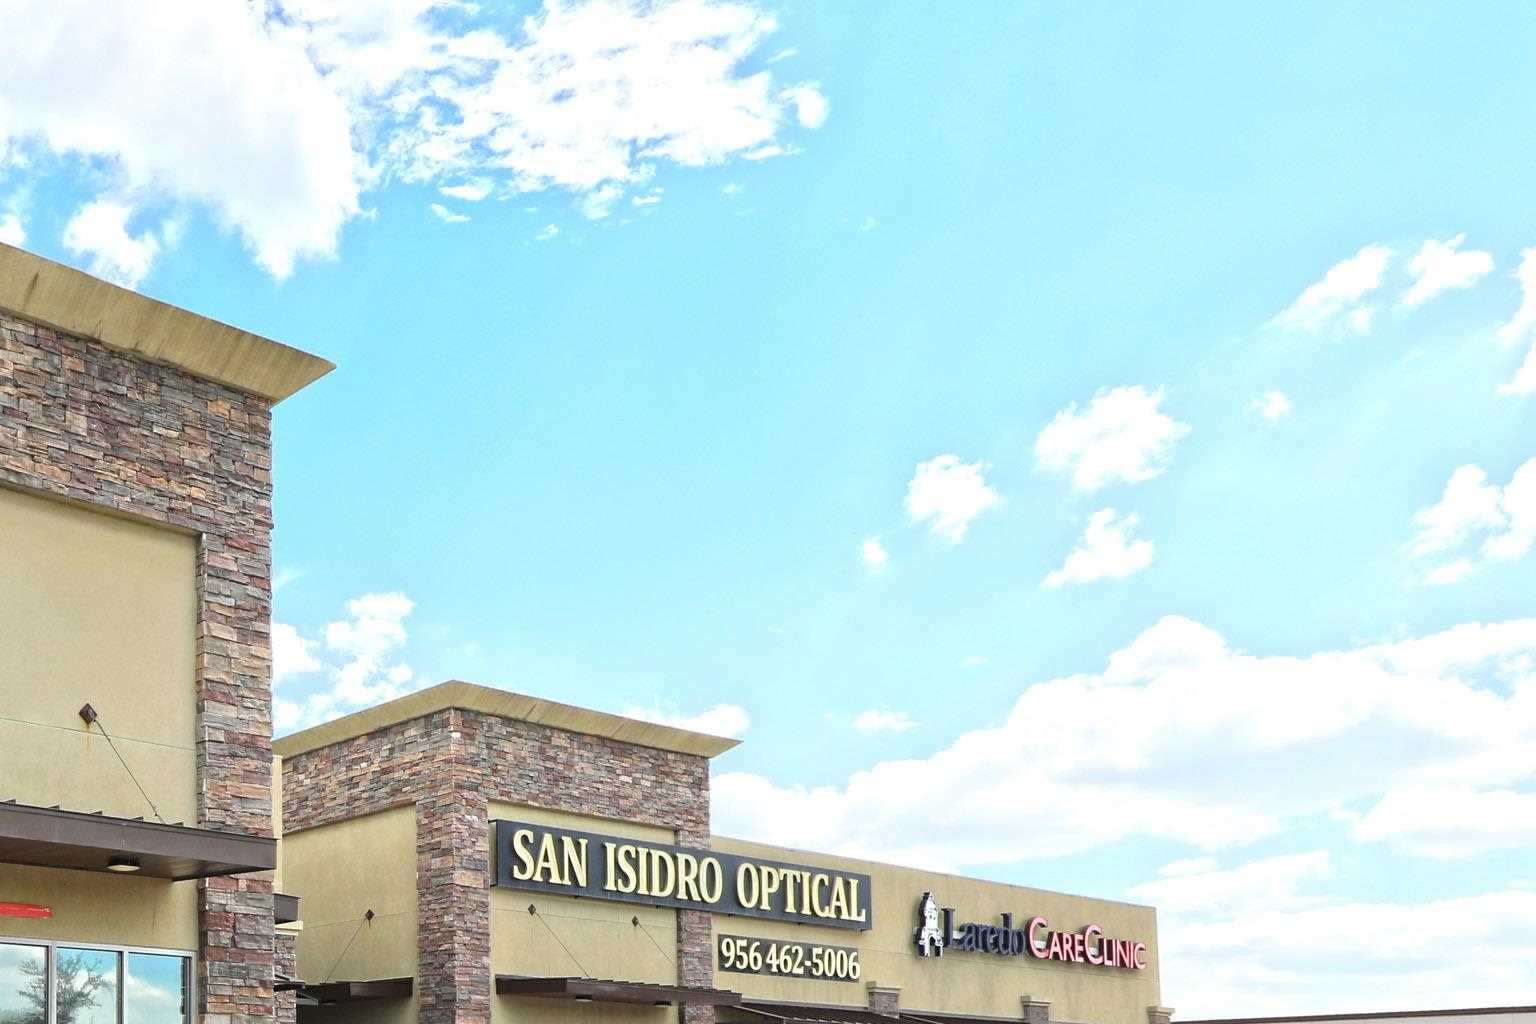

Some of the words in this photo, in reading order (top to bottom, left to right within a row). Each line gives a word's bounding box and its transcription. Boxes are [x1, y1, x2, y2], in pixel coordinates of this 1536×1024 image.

[513, 829, 589, 888] SAN
[603, 842, 724, 903] ISIDRO
[736, 862, 867, 922] OPTICAL
[941, 907, 1027, 956] Laredo
[721, 937, 764, 971] 956
[765, 943, 861, 980] 462-5006
